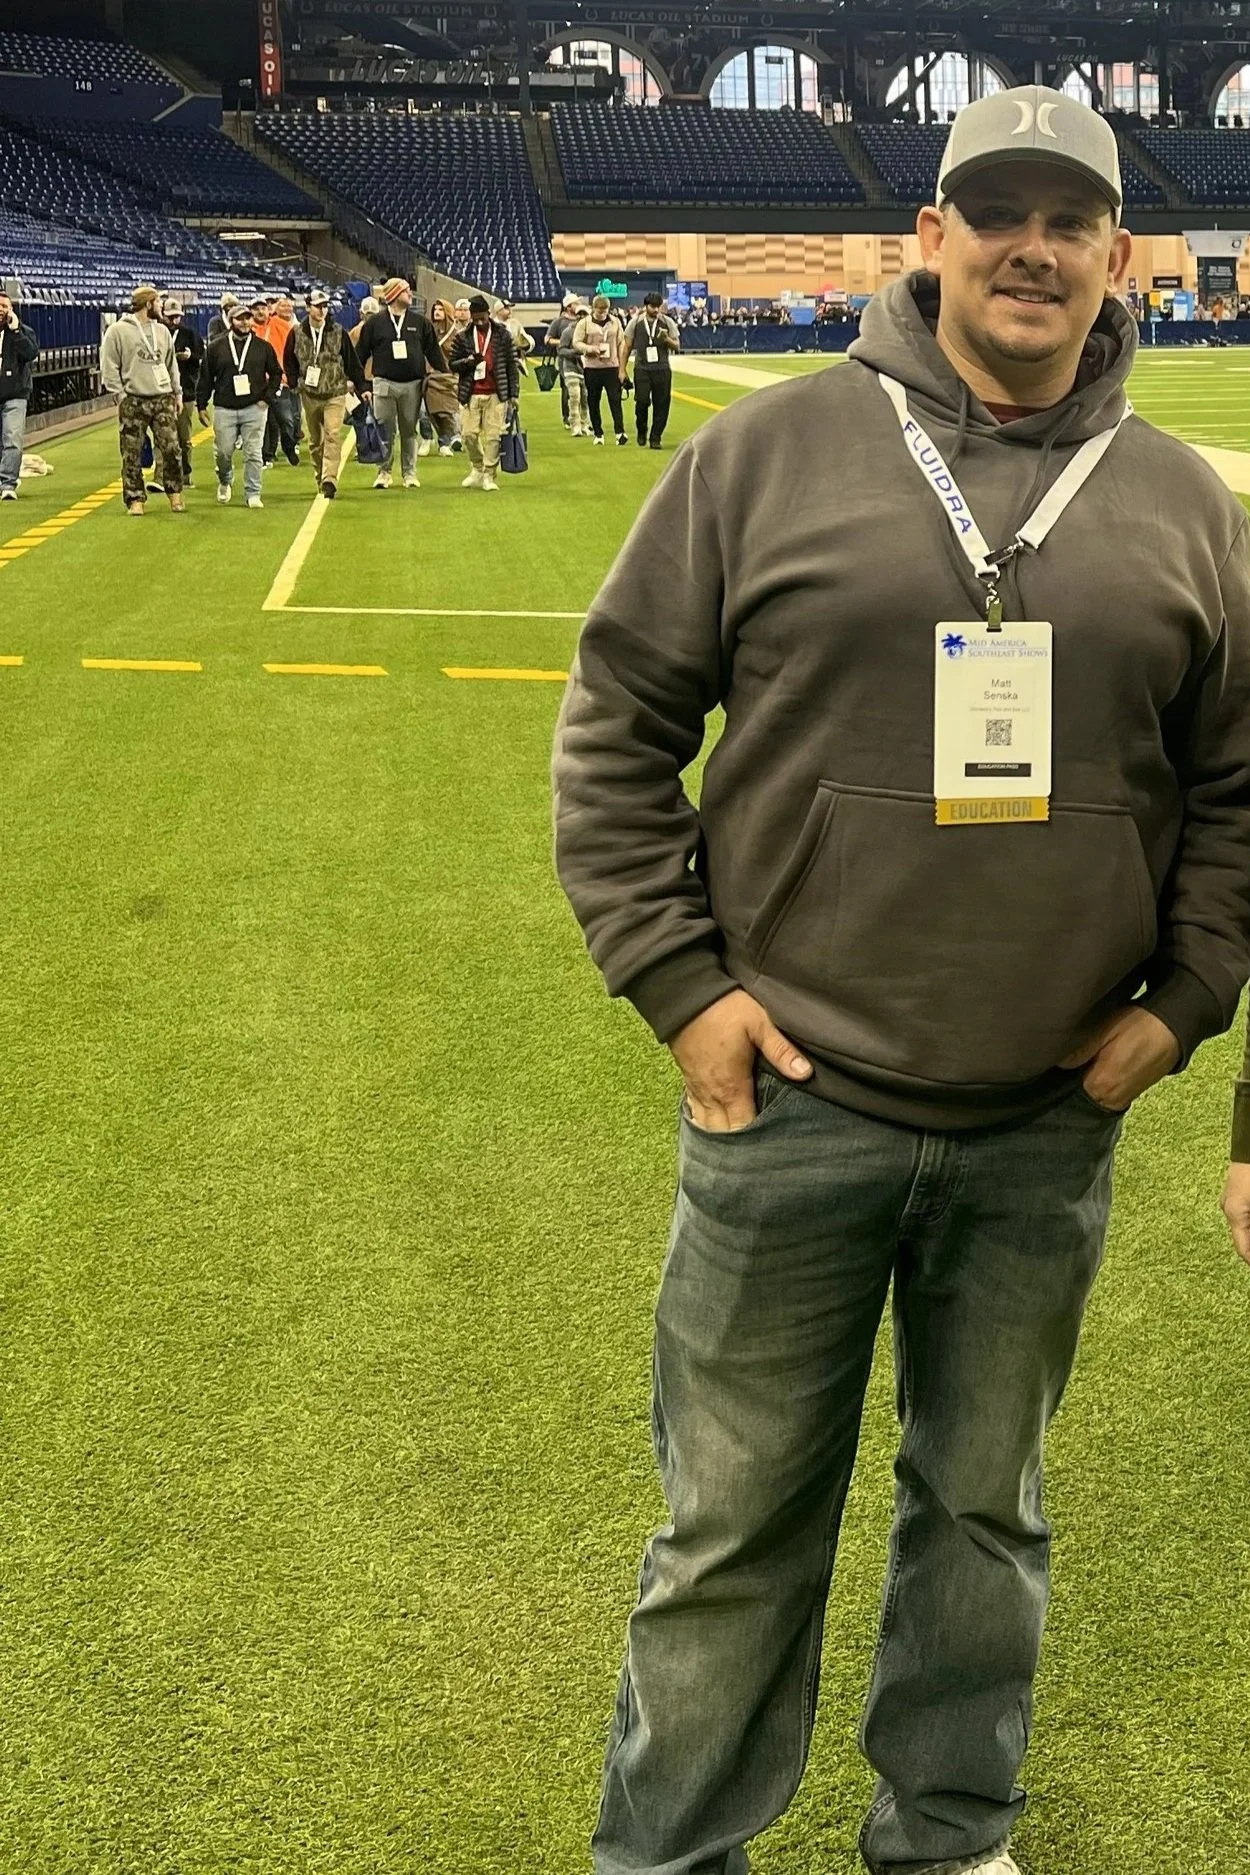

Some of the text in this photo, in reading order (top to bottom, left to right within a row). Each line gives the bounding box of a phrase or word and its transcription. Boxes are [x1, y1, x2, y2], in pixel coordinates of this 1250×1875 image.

[405, 5, 472, 15] STADIUM
[611, 10, 749, 24] LUCAS OIL STADIUM
[352, 59, 438, 84] LUCAS
[75, 80, 92, 91] 148
[904, 420, 973, 535] FLUIDRA
[991, 679, 1012, 688] Matt
[984, 691, 1018, 701] Senska
[950, 800, 1032, 820] EDUCATION
